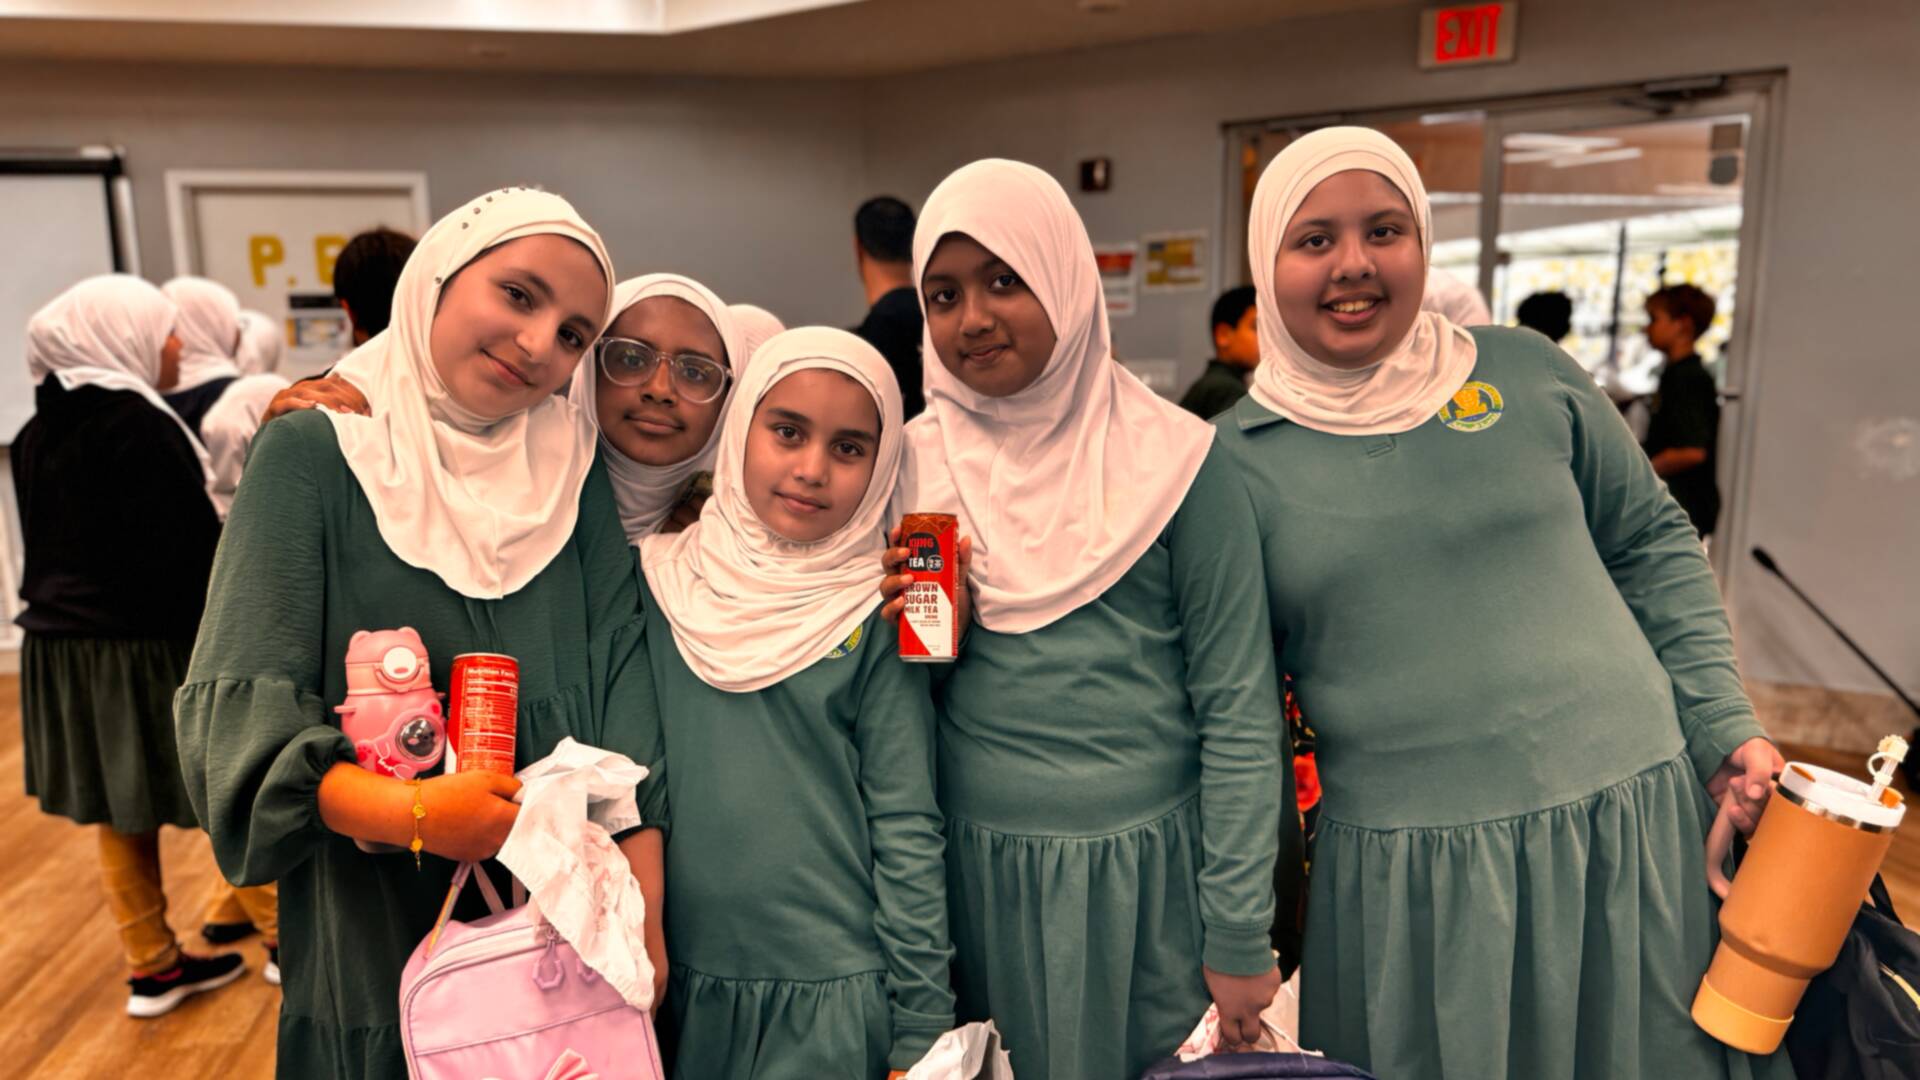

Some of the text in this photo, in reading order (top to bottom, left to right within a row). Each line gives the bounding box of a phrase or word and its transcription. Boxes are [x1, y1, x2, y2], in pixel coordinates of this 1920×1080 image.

[1436, 4, 1503, 63] EXIT
[909, 538, 934, 548] KUNG
[909, 557, 925, 567] TEA
[905, 594, 938, 605] SUGAR
[923, 605, 938, 614] TEA
